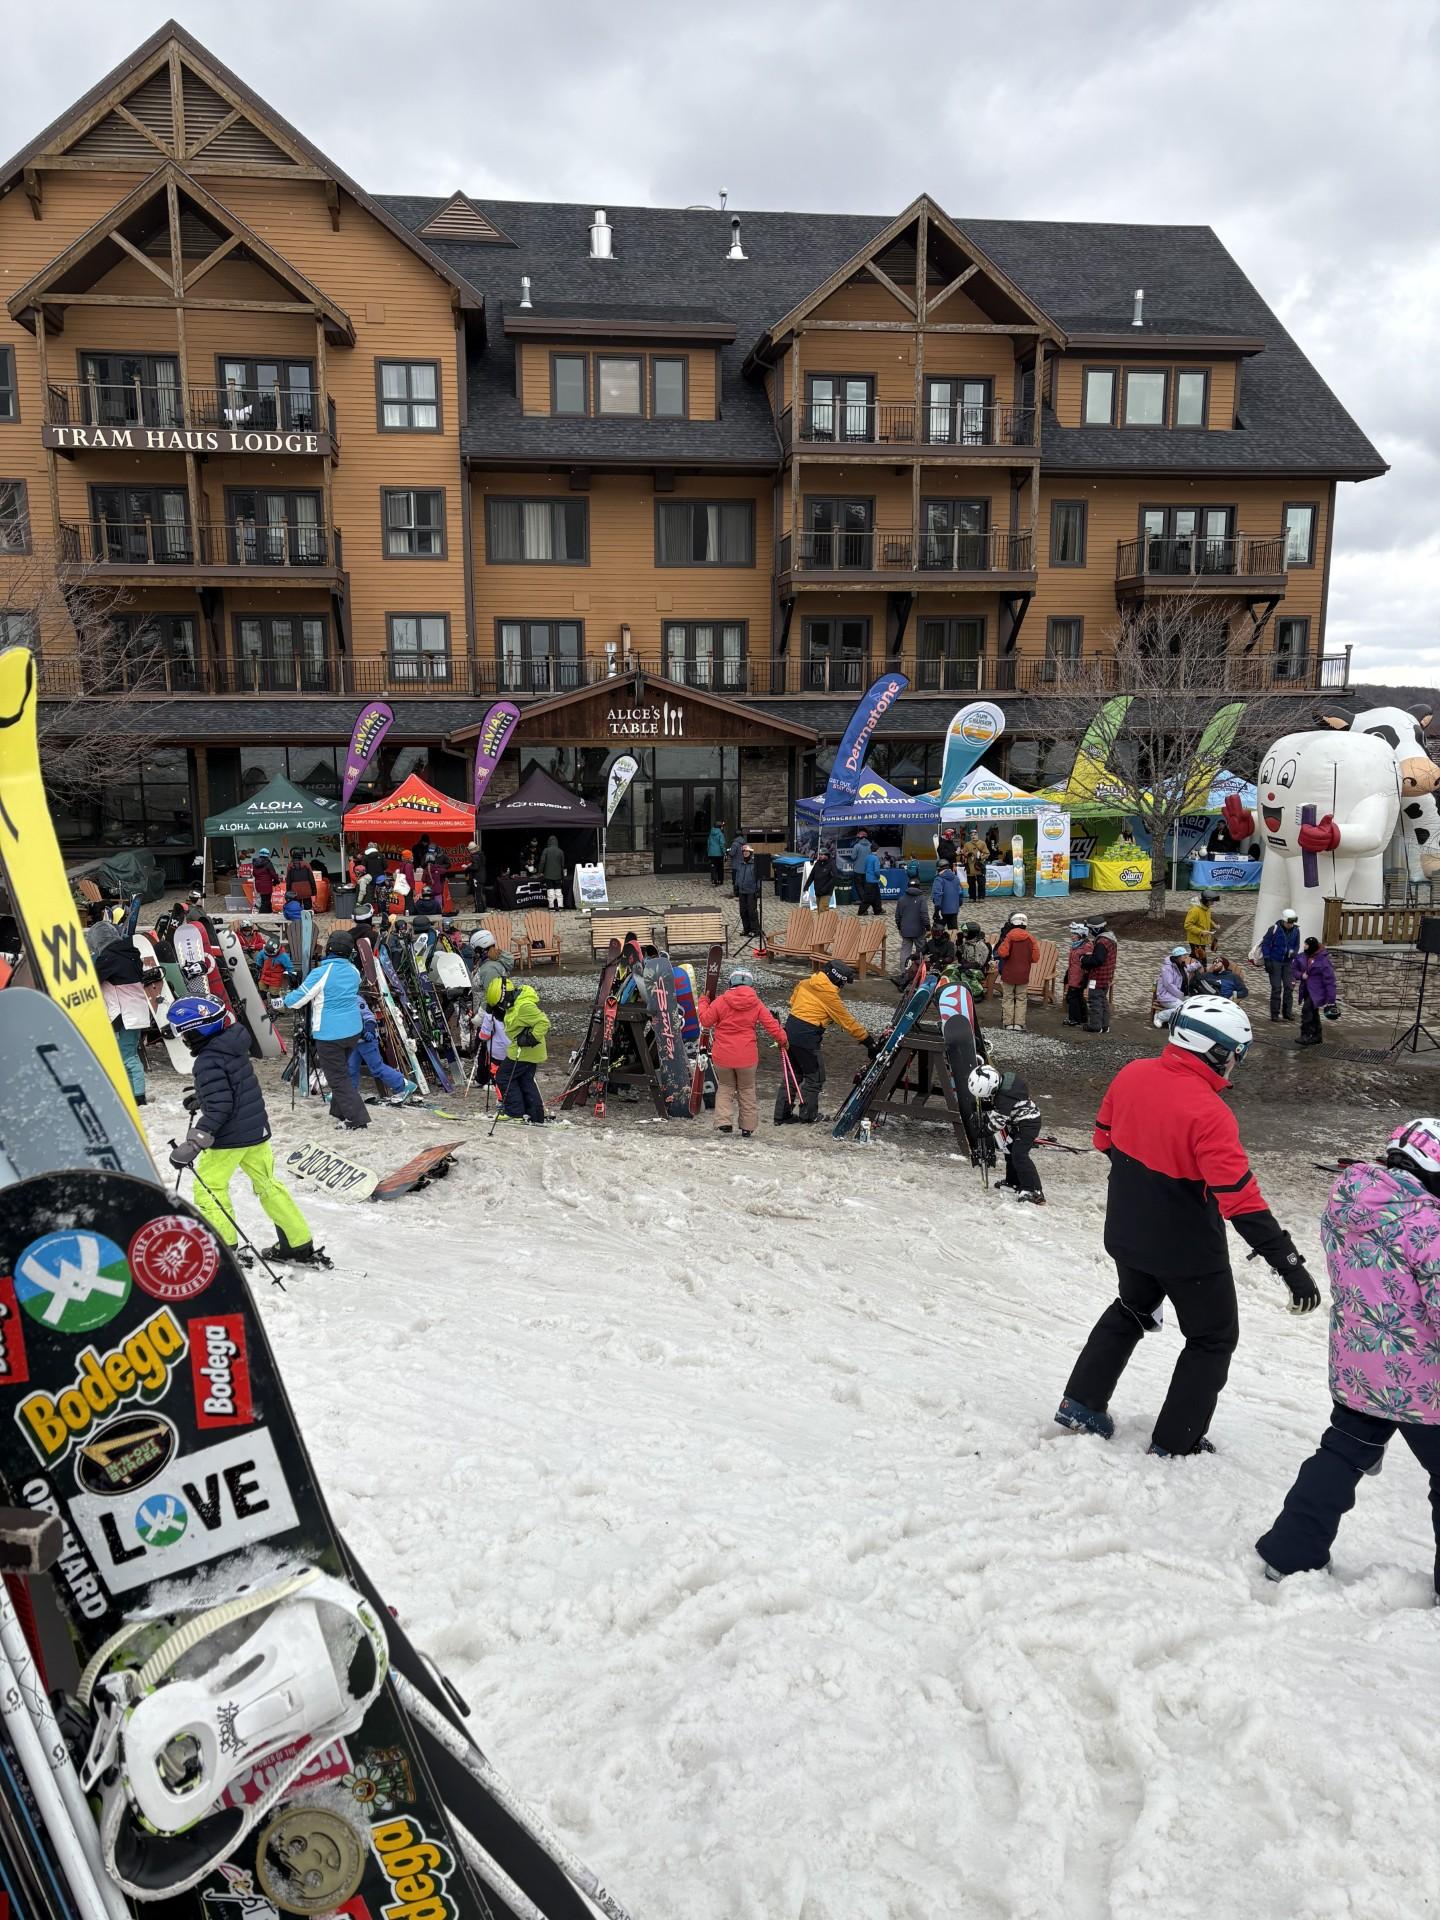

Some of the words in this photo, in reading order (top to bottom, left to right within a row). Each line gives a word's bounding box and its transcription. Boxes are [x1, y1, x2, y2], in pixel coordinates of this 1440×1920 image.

[53, 428, 134, 448] TRAM
[146, 430, 219, 450] HAUS
[230, 433, 319, 453] LODGE
[607, 705, 661, 720] ALICE'S
[610, 722, 659, 734] TABLE
[845, 681, 900, 772] Dermatone
[247, 801, 304, 810] ALOHA
[529, 802, 572, 810] CHEVROLET
[854, 797, 916, 805] rmatone
[965, 808, 988, 816] SUN
[991, 807, 1036, 815] CRUISER
[219, 823, 250, 831] ALOHA
[257, 822, 289, 830] ALOHA
[296, 821, 328, 829] ALOHA
[1120, 868, 1143, 883] Starry
[516, 894, 548, 904] CHEVROL
[831, 968, 847, 981] GIRO
[298, 1148, 367, 1190] ARBOR
[203, 1324, 236, 1415] Bodega
[21, 1310, 184, 1456] Bodega
[105, 1438, 155, 1473] IN-N-OUT
[110, 1447, 161, 1483] BURGER
